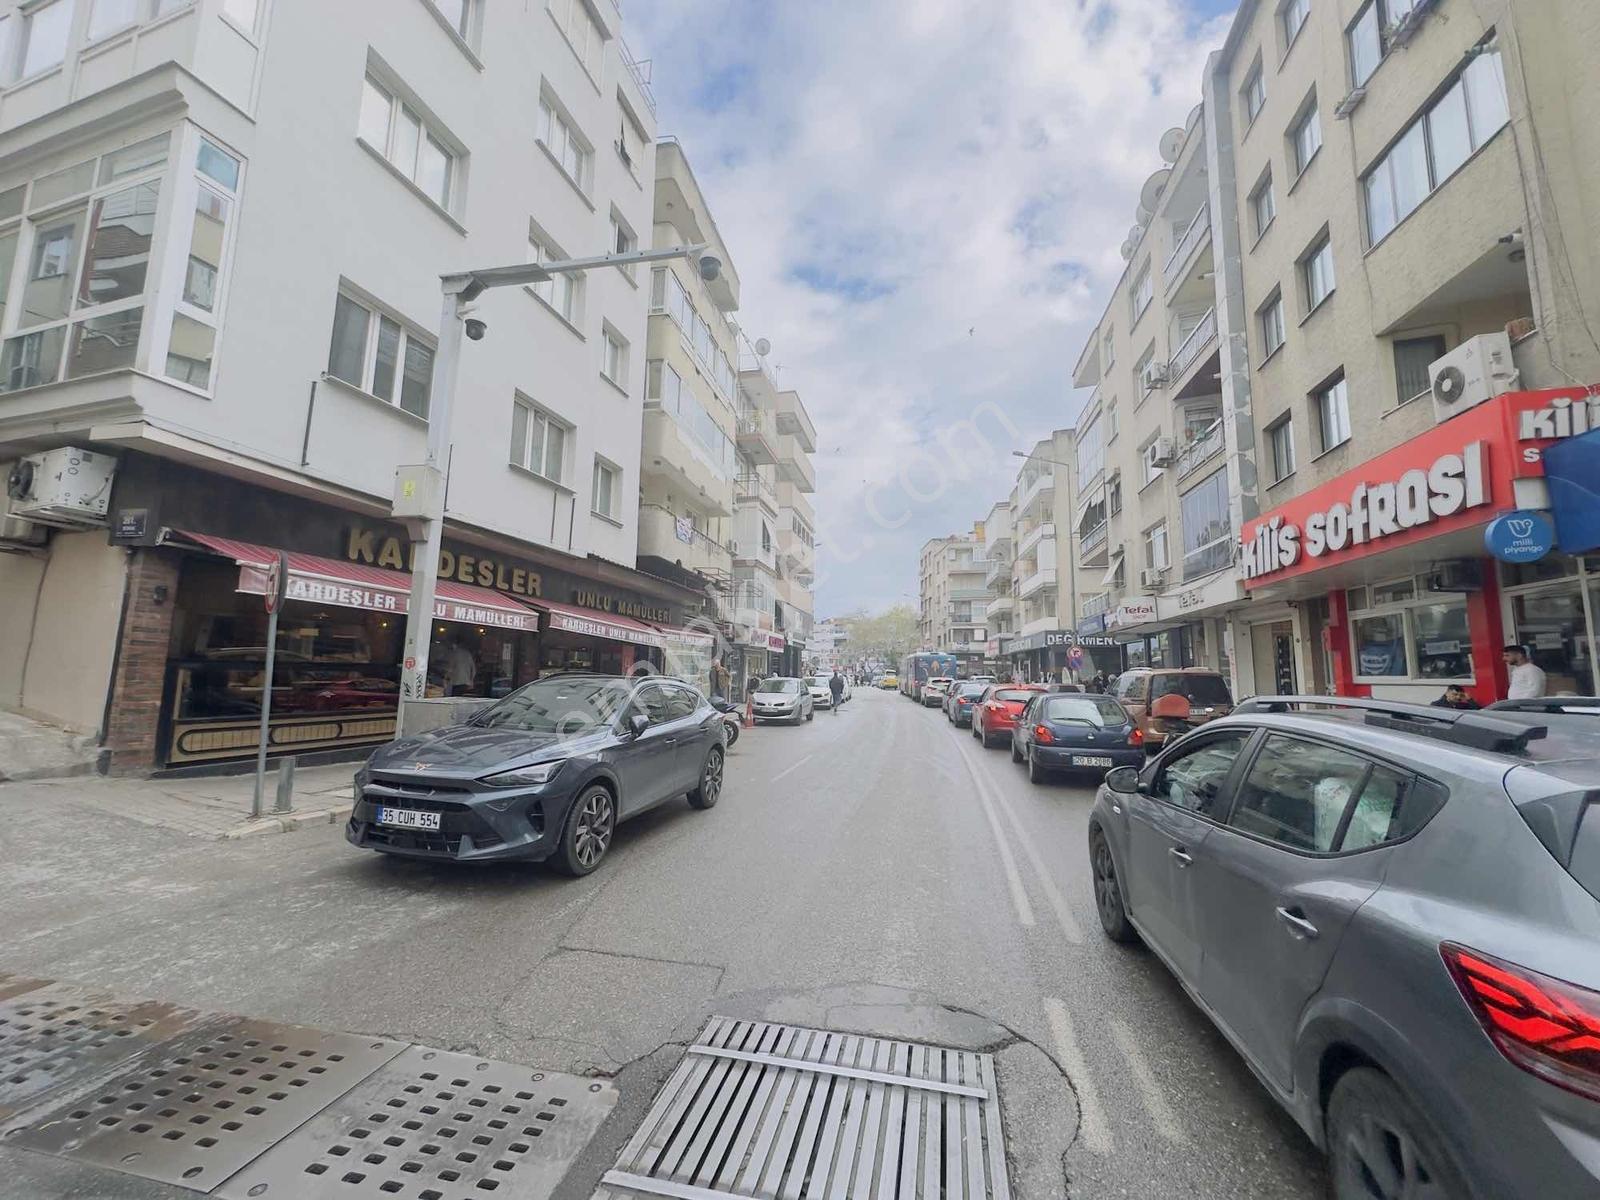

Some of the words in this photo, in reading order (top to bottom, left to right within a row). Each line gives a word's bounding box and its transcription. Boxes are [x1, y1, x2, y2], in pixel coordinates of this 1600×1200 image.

[348, 528, 541, 597] KADESLER
[1123, 606, 1153, 614] Tefal
[383, 809, 394, 822] 35
[398, 811, 416, 825] CUH
[420, 813, 438, 828] 554
